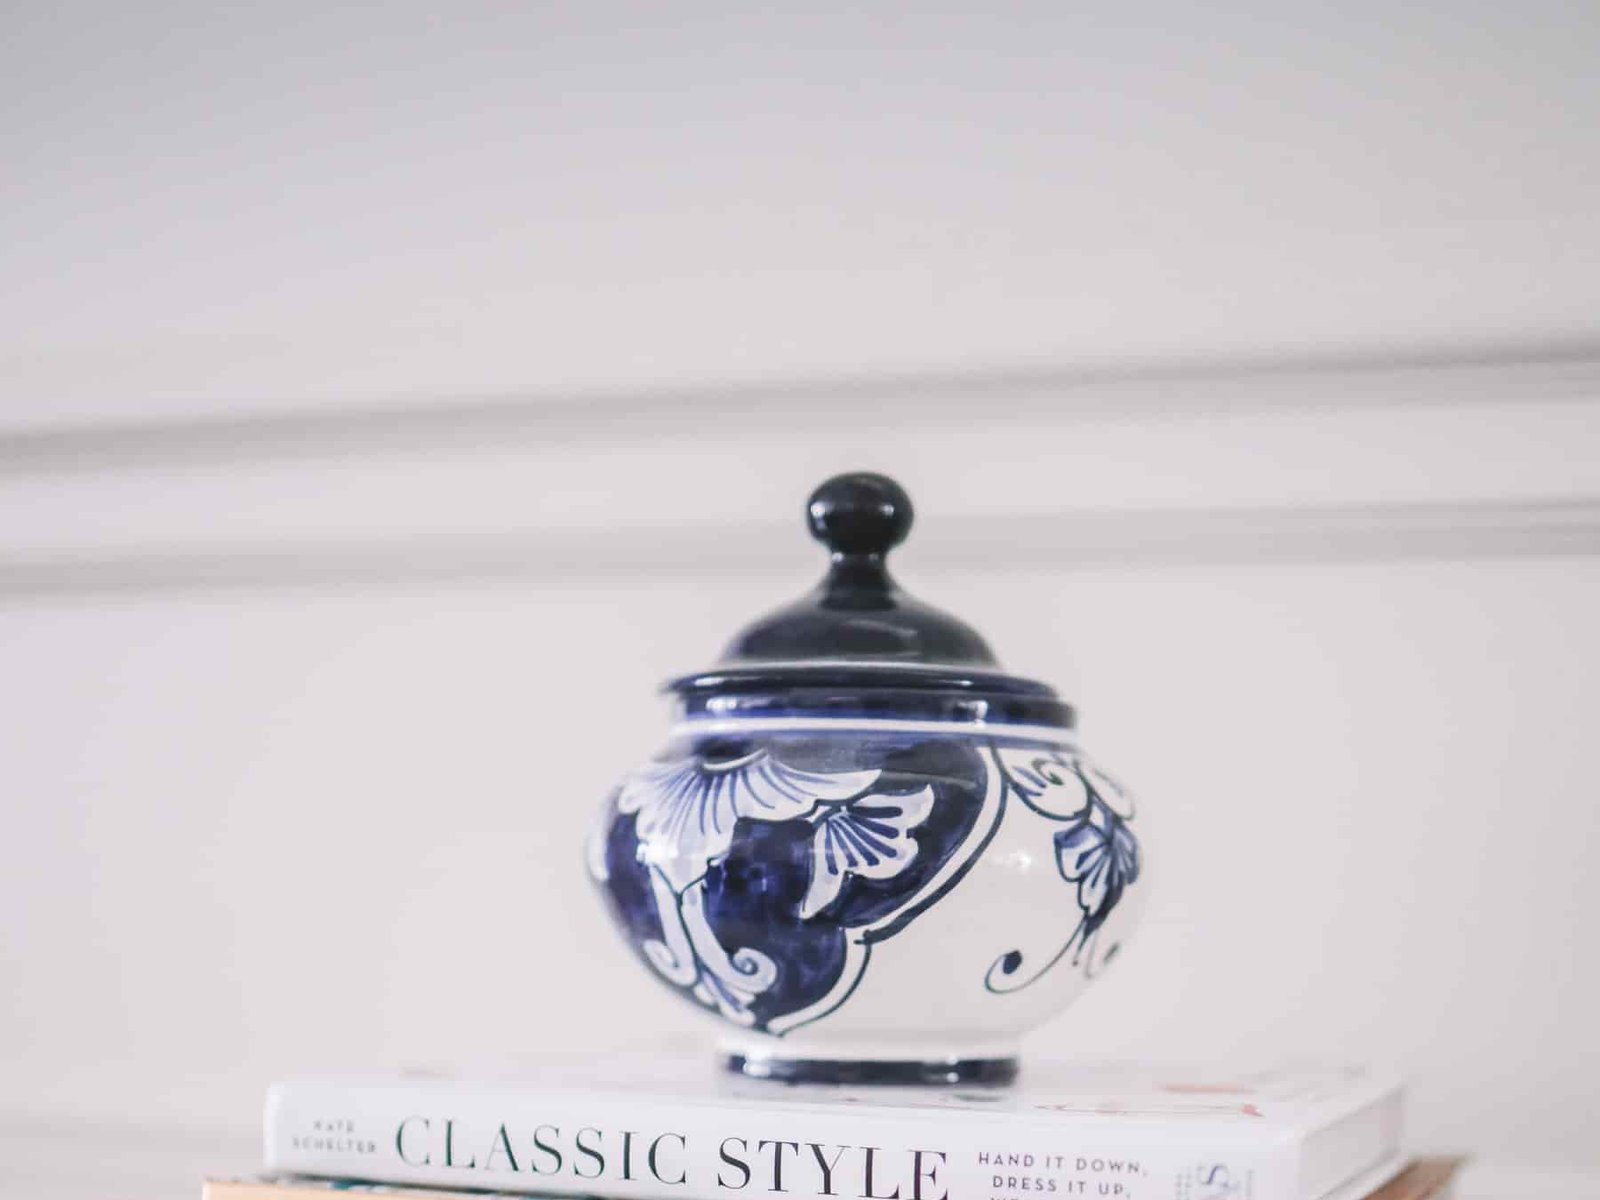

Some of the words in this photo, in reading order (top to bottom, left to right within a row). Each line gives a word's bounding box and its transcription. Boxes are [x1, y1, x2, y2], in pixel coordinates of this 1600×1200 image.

[395, 1116, 688, 1185] CLASSIC
[978, 1151, 1035, 1168] HAND
[1045, 1155, 1065, 1169] IT
[1076, 1157, 1149, 1177] DOWN,
[992, 1175, 1057, 1192] DRESS
[1068, 1180, 1086, 1194] IT
[1098, 1183, 1132, 1199] UP,
